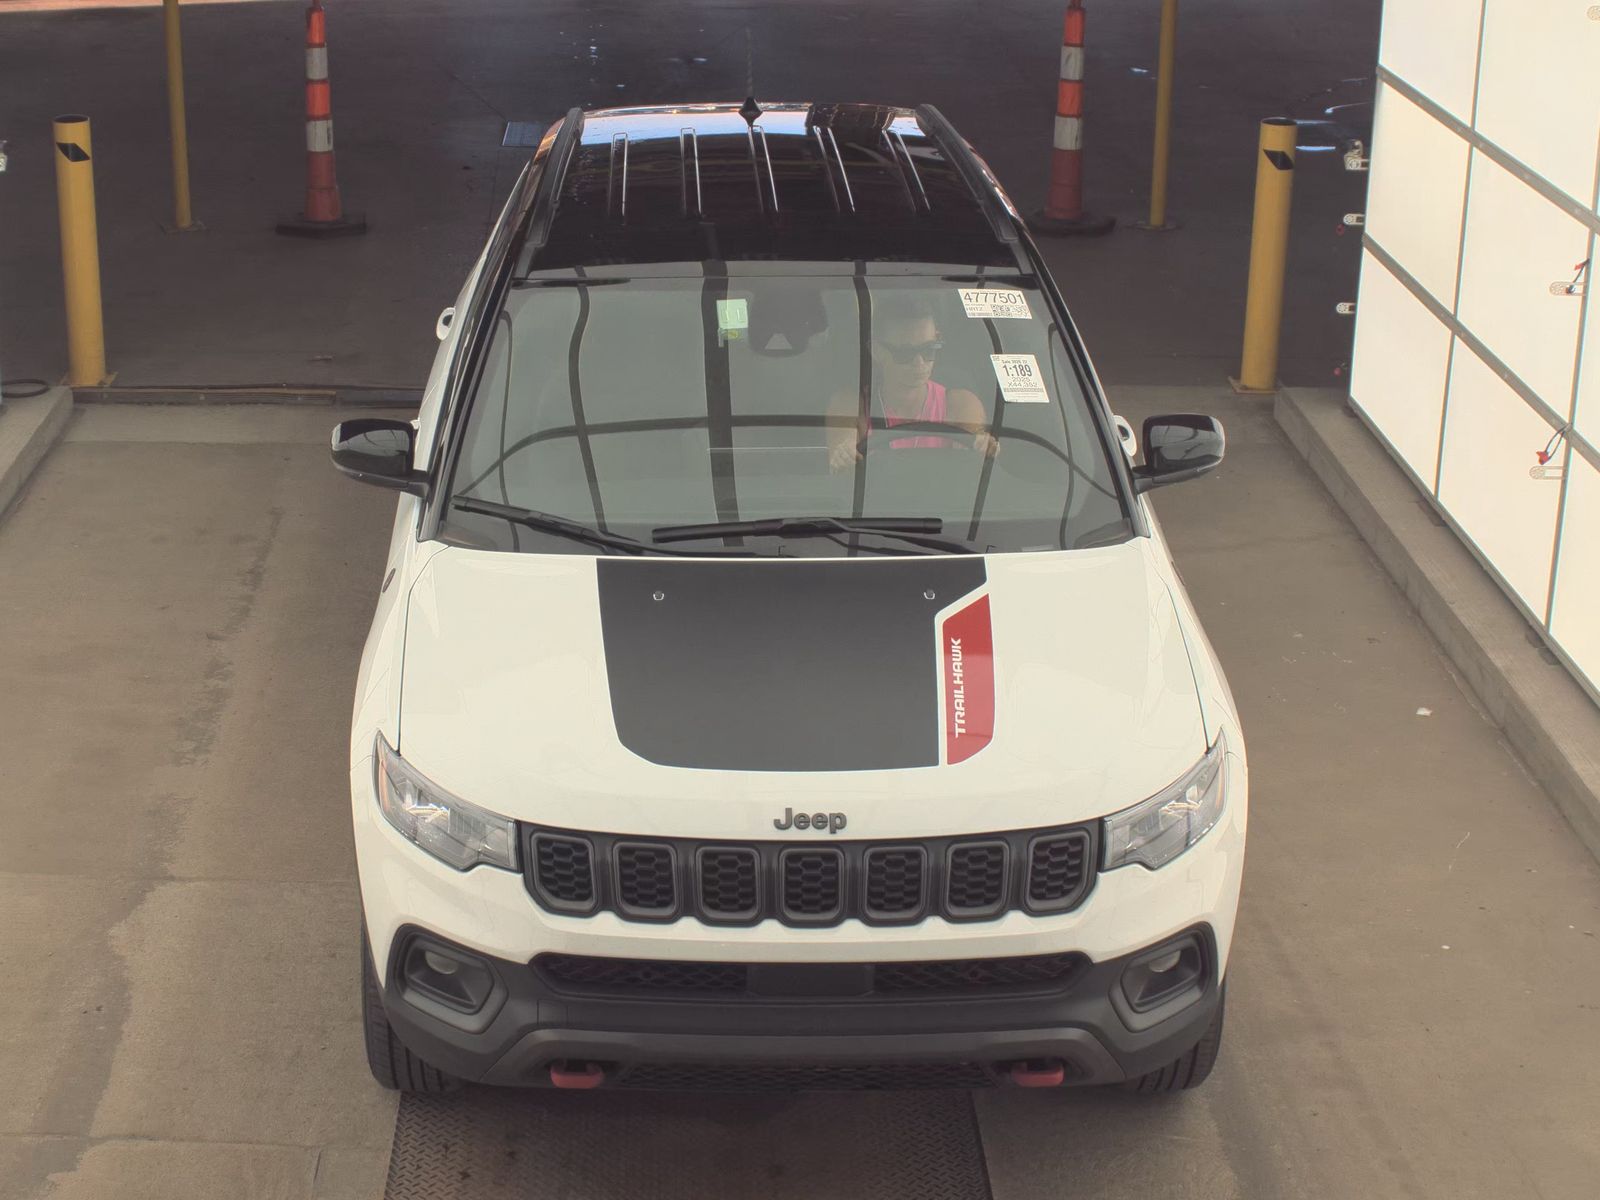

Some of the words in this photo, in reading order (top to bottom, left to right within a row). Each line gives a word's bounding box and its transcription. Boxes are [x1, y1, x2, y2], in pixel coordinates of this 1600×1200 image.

[964, 292, 1024, 304] 4777501
[1003, 364, 1032, 377] 1:189
[951, 637, 966, 738] TRAILHAWK
[774, 807, 847, 834] Jeep
